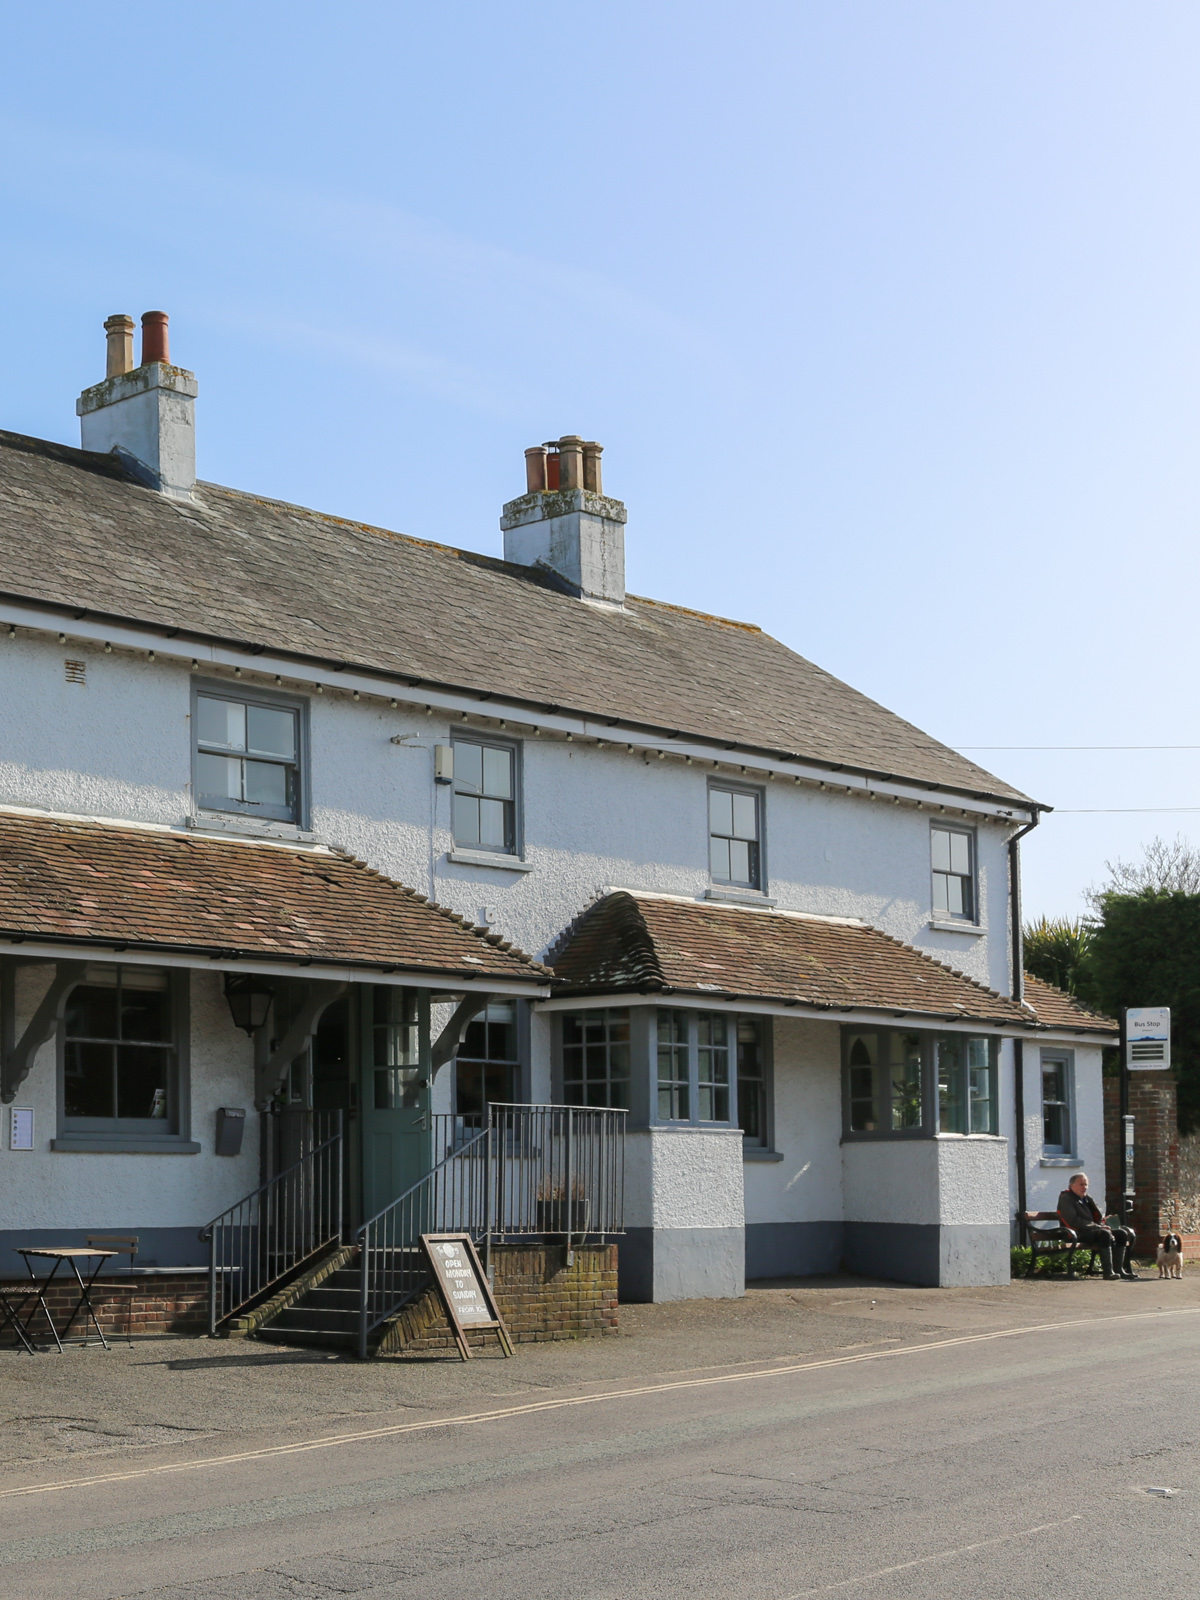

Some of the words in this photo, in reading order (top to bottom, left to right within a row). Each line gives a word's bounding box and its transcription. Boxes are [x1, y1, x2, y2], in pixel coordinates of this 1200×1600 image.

[1147, 1020, 1161, 1028] Stop
[445, 1260, 462, 1268] OPEN
[446, 1269, 472, 1278] MONDAY
[455, 1280, 464, 1288] TO
[452, 1290, 477, 1300] SUNDAY
[458, 1306, 475, 1314] FROM
